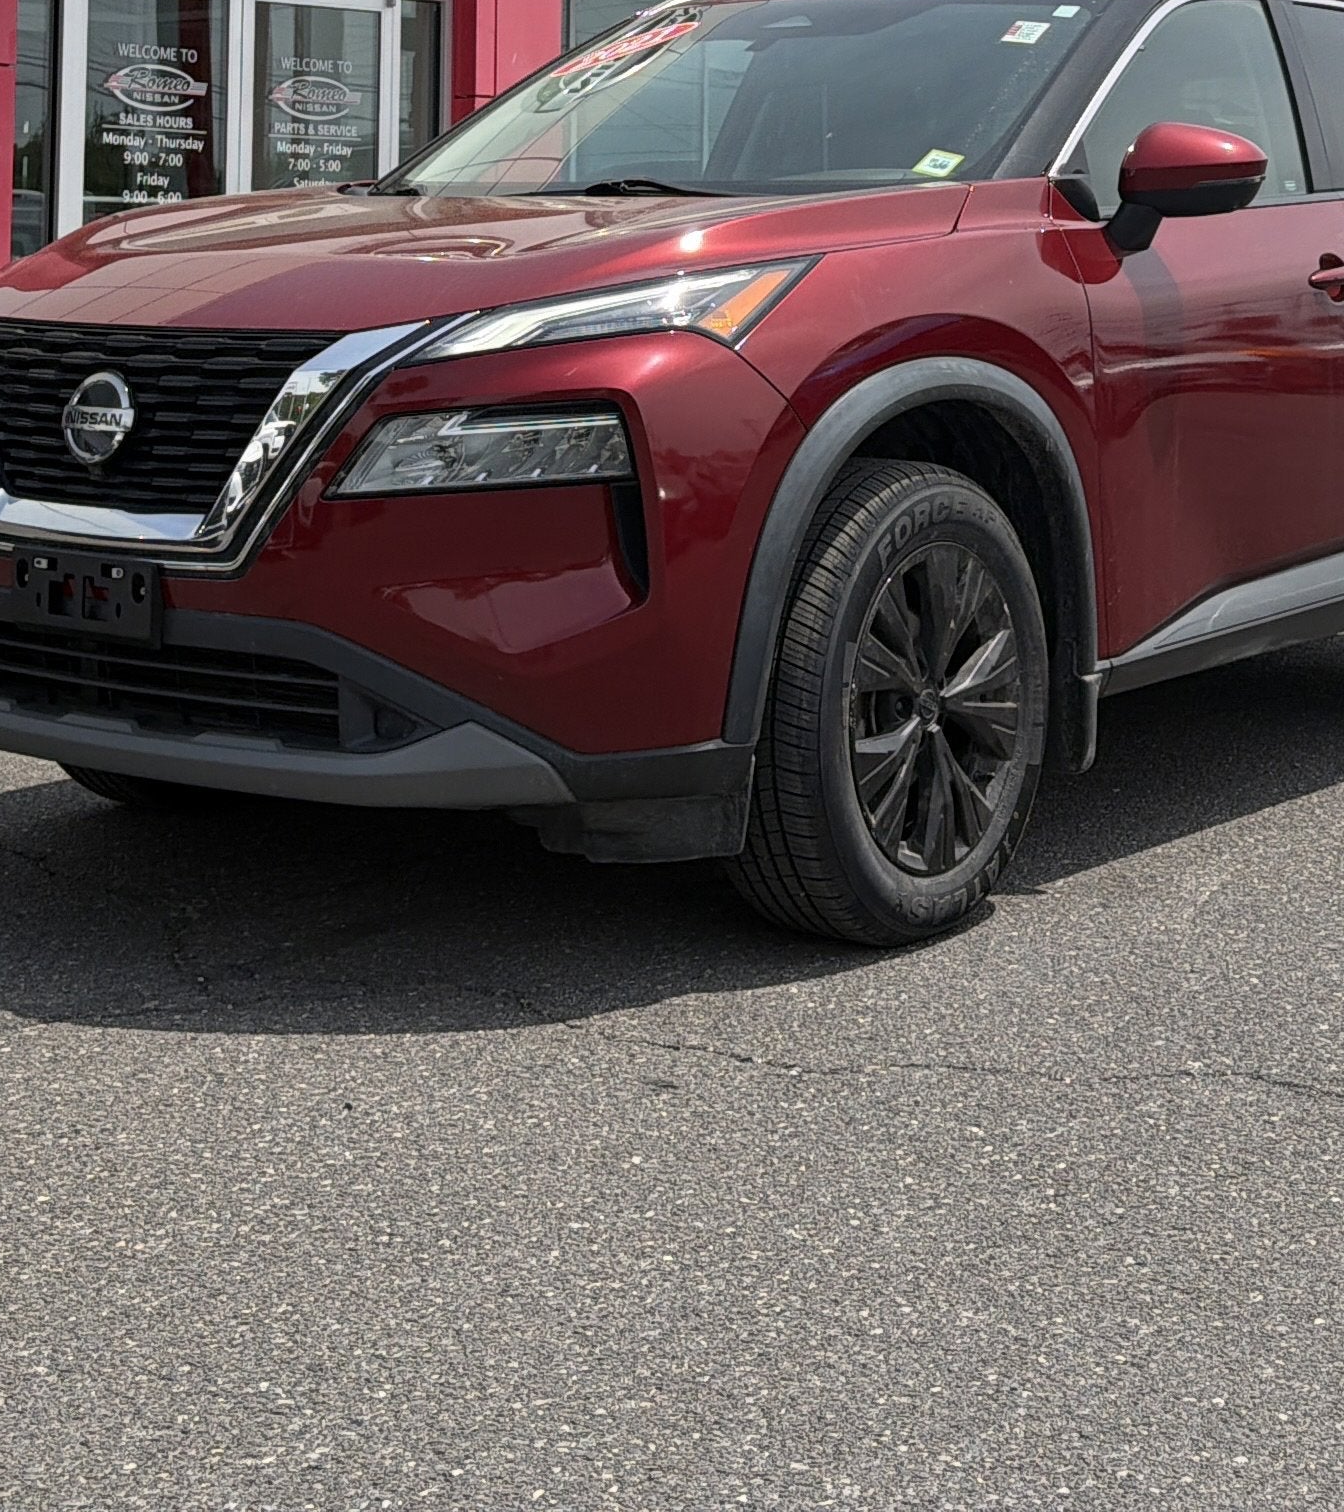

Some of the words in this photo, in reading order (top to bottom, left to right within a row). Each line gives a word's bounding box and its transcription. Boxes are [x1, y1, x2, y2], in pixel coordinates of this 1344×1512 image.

[117, 42, 178, 62] WELCOME
[179, 49, 198, 64] TO
[281, 57, 334, 73] WELCOME
[336, 61, 353, 74] TO
[123, 67, 191, 92] Romeo
[132, 91, 179, 104] NISSAN
[291, 79, 347, 100] Romeo
[295, 102, 337, 113] NISSAN
[119, 112, 154, 126] SALES
[156, 116, 193, 129] HOURS
[274, 122, 306, 135] PARTS
[307, 123, 316, 135] &
[317, 124, 358, 137] SERVICE
[102, 132, 146, 149] Monday
[155, 135, 205, 153] Thursday
[276, 140, 316, 157] Monday
[323, 143, 353, 158] Friday
[123, 151, 149, 165] 9:00
[158, 153, 183, 167] 7:00
[288, 158, 311, 171] 7:00
[319, 159, 342, 172] 5:00
[136, 172, 170, 189] Friday
[122, 189, 148, 203] 9:00
[157, 191, 182, 205] 6:00
[65, 410, 123, 426] NISSAN
[876, 495, 969, 572] FORCE
